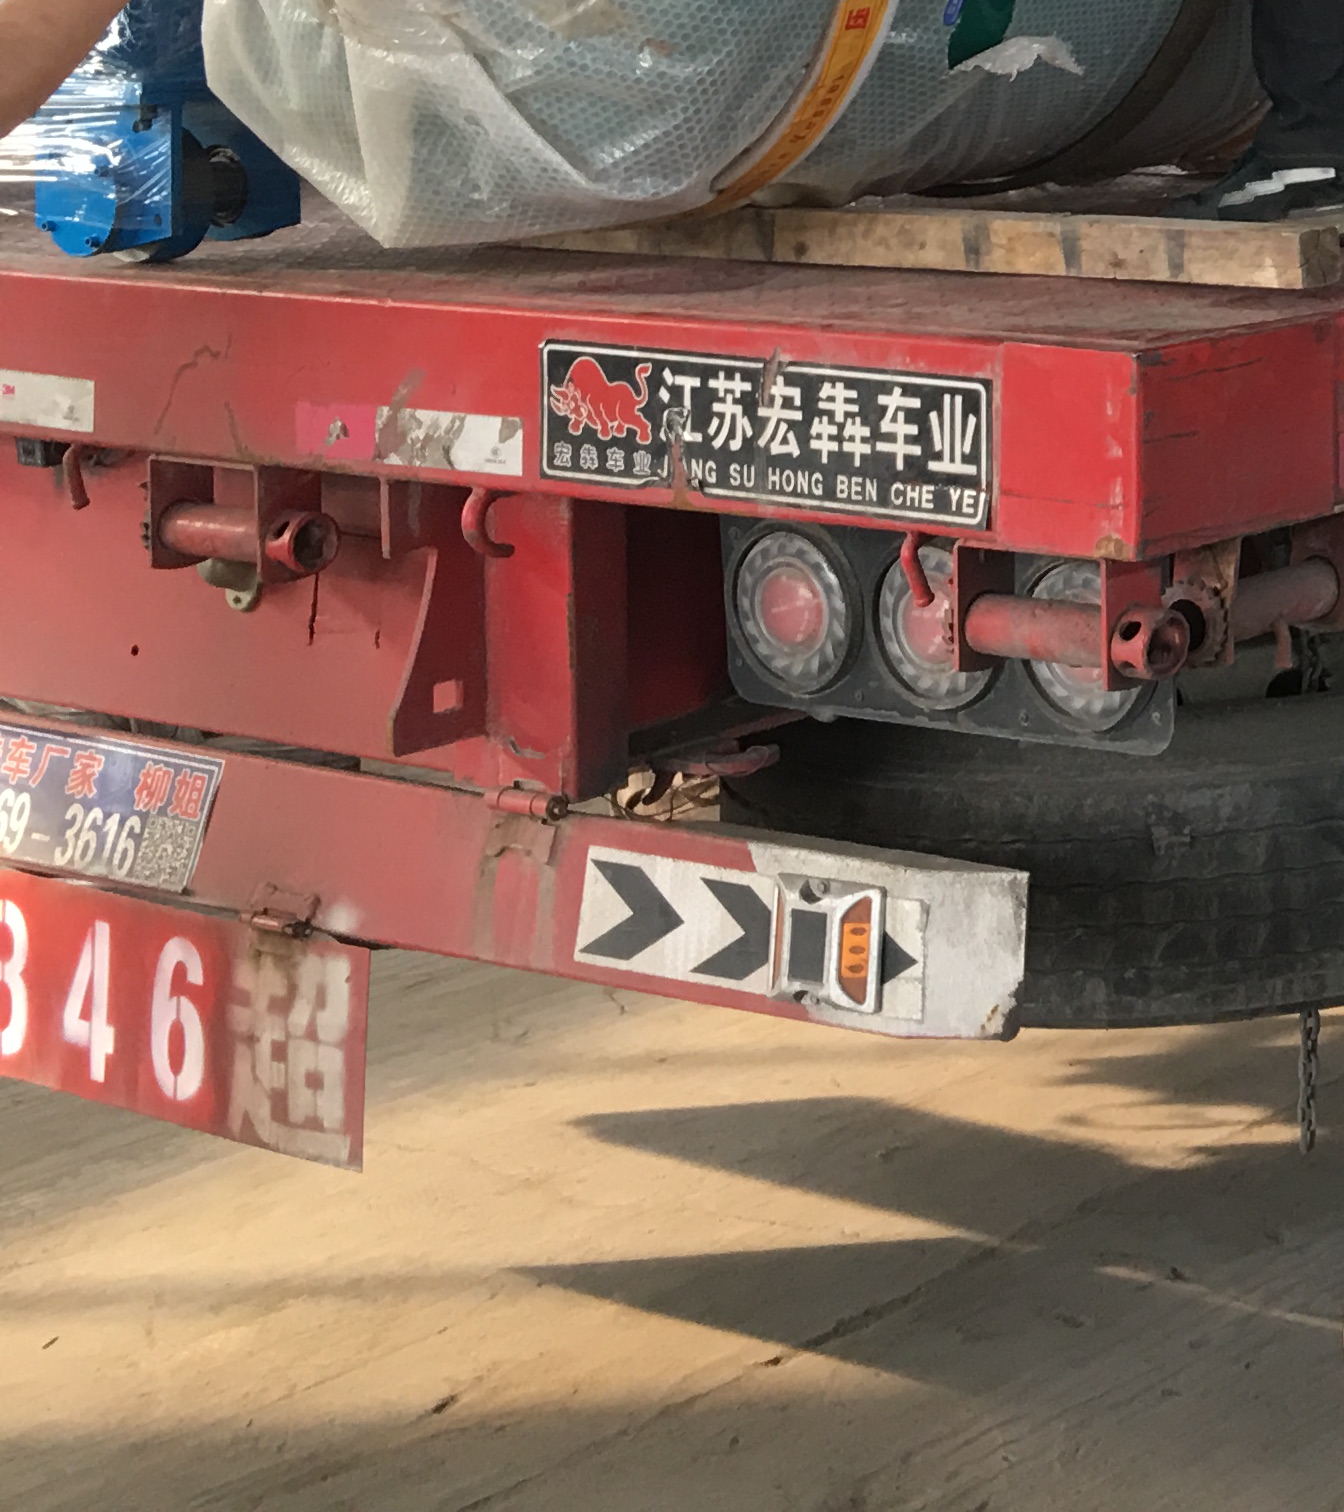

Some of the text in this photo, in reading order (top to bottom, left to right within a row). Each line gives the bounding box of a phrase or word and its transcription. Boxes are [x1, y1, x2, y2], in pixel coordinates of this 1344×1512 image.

[552, 440, 652, 476] 宏犇车业
[658, 366, 978, 476] 江苏宏犇车业
[657, 454, 975, 514] JNG SU HONG BEN CHE YE
[0, 732, 209, 821] 车厂家 柳姐
